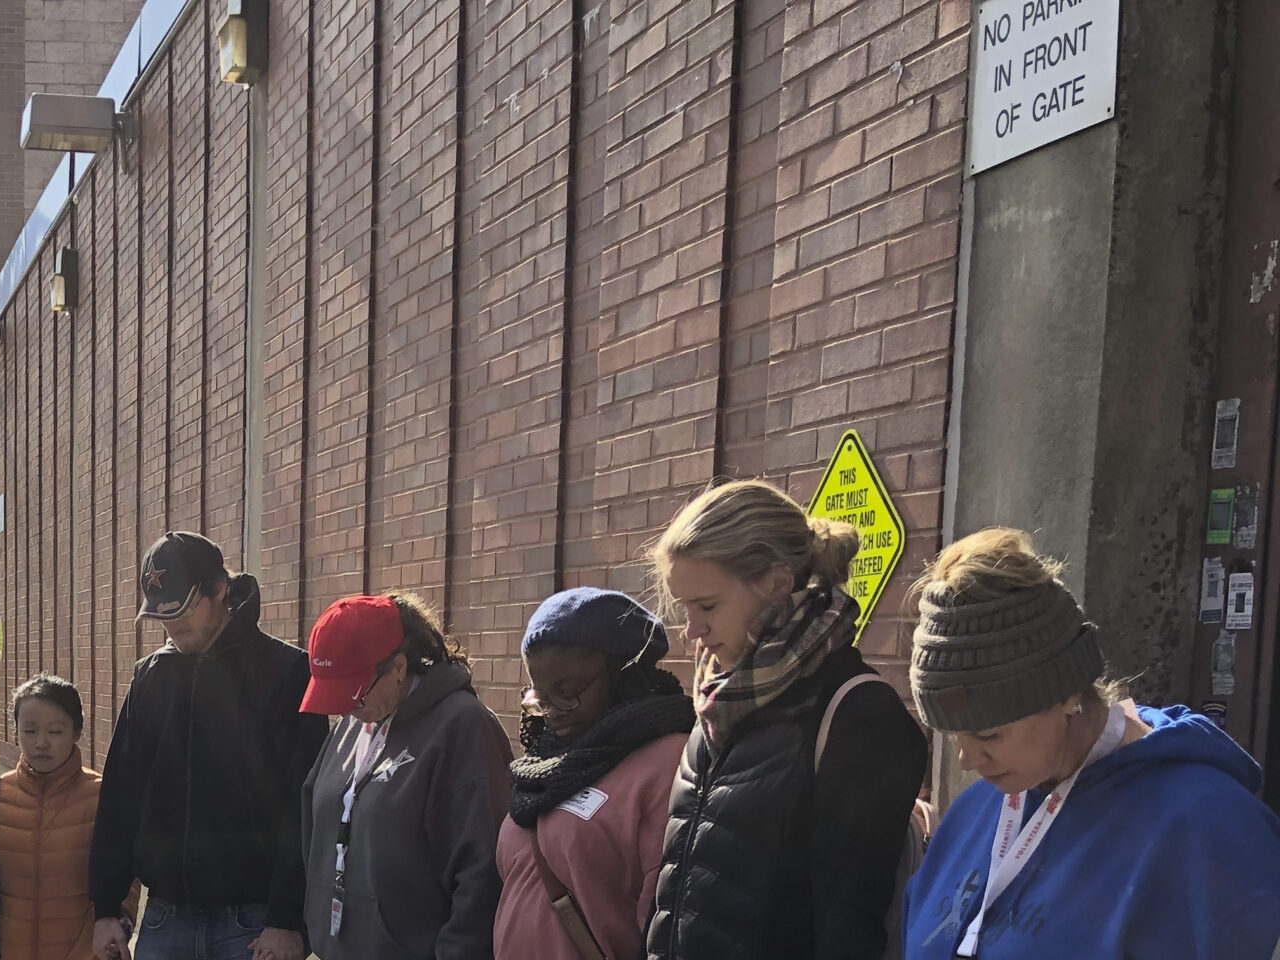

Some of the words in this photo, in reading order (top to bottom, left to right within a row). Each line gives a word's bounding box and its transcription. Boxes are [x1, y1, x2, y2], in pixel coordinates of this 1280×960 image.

[983, 13, 1011, 51] NO
[993, 60, 1012, 93] IN
[1023, 21, 1093, 79] FRONT
[995, 103, 1022, 139] OF
[1032, 74, 1086, 122] GATE
[839, 467, 857, 487] THIS
[825, 493, 845, 512] GATE
[846, 488, 869, 507] MUST
[858, 510, 876, 528] AND
[876, 530, 894, 549] USE.
[852, 581, 869, 598] USE.
